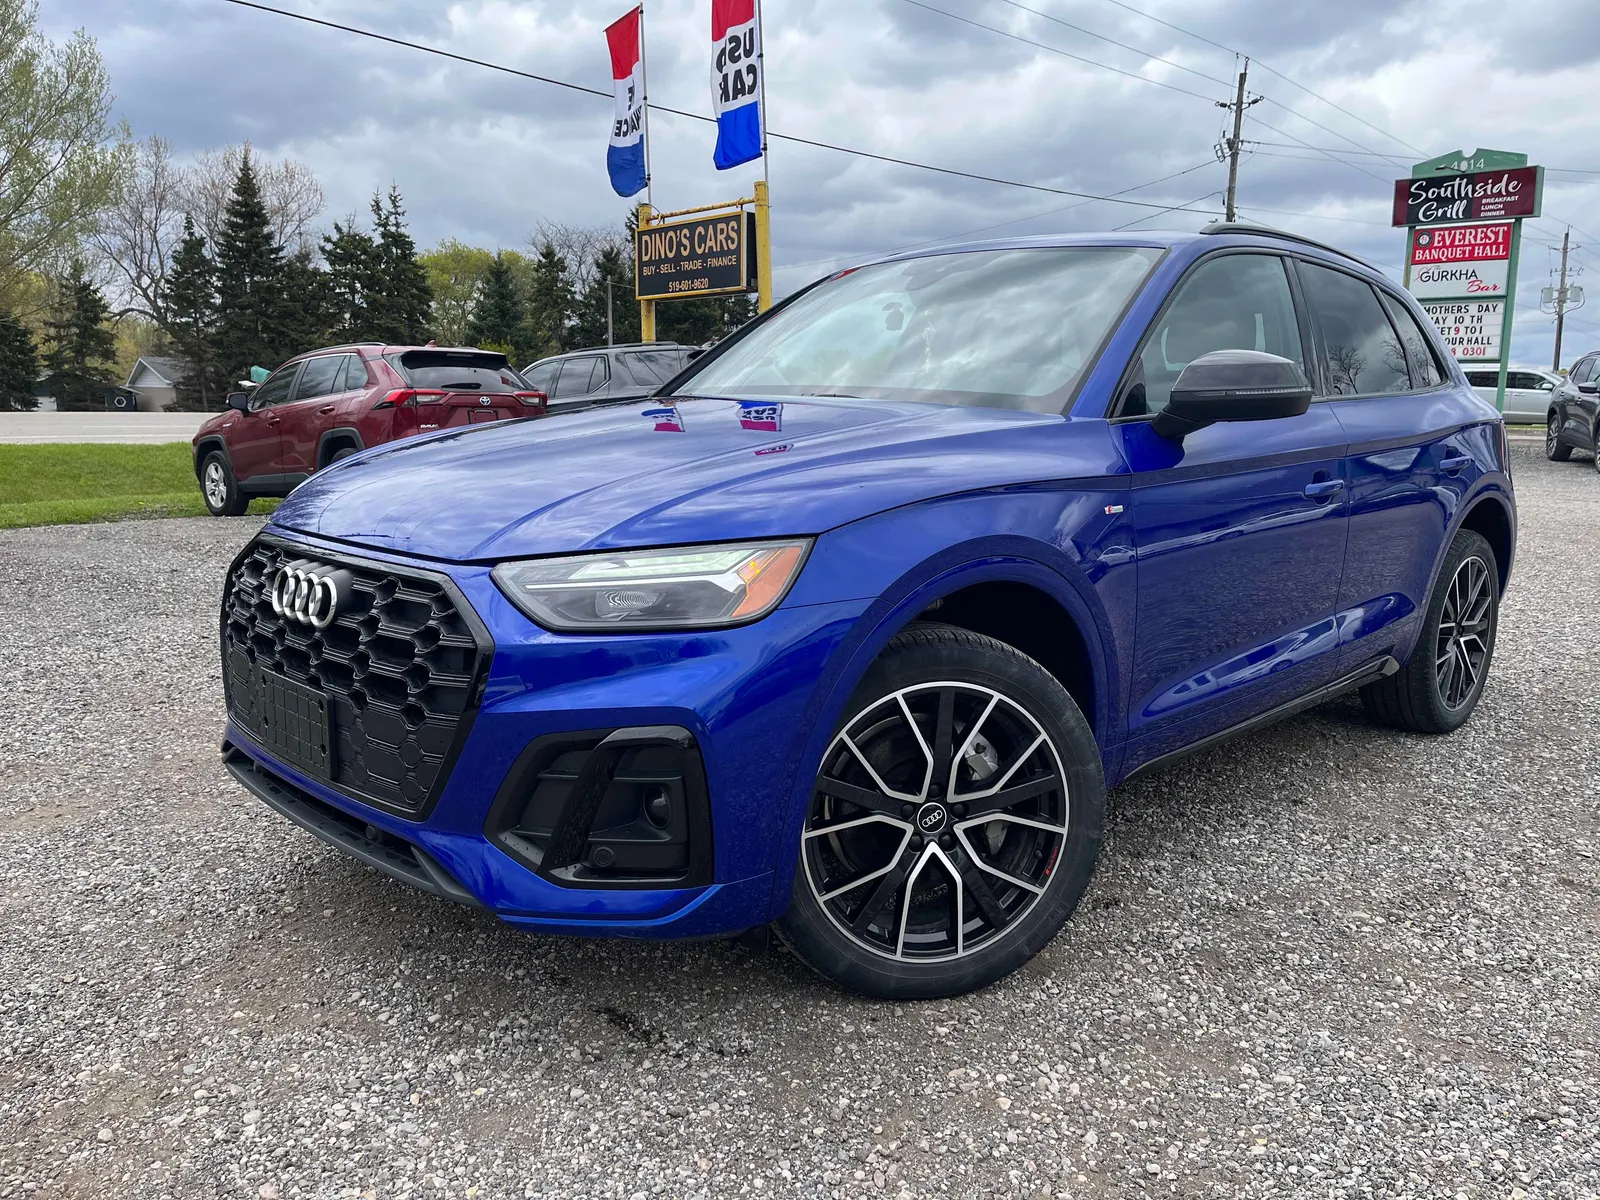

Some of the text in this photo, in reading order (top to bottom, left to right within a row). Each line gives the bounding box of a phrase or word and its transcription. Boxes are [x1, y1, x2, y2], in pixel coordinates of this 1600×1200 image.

[1451, 158, 1485, 170] 4014
[1408, 174, 1522, 205] Southside
[1481, 195, 1519, 204] BREAKFAST
[1418, 200, 1467, 222] Grill
[641, 220, 739, 262] DINO'S CARS
[1433, 226, 1508, 247] EVEREST
[1415, 244, 1506, 262] BANQUET HALL
[643, 266, 656, 276] BUY
[660, 263, 676, 274] SELL
[680, 260, 703, 272] TRADE
[707, 255, 737, 268] FINANCE
[1420, 269, 1479, 283] GURKHA
[668, 278, 709, 292] 519-601-9620
[1466, 279, 1501, 293] Bar
[1477, 303, 1498, 313] DAY
[1431, 316, 1448, 325] AY
[1454, 326, 1460, 335] 9
[1466, 336, 1492, 346] HALL
